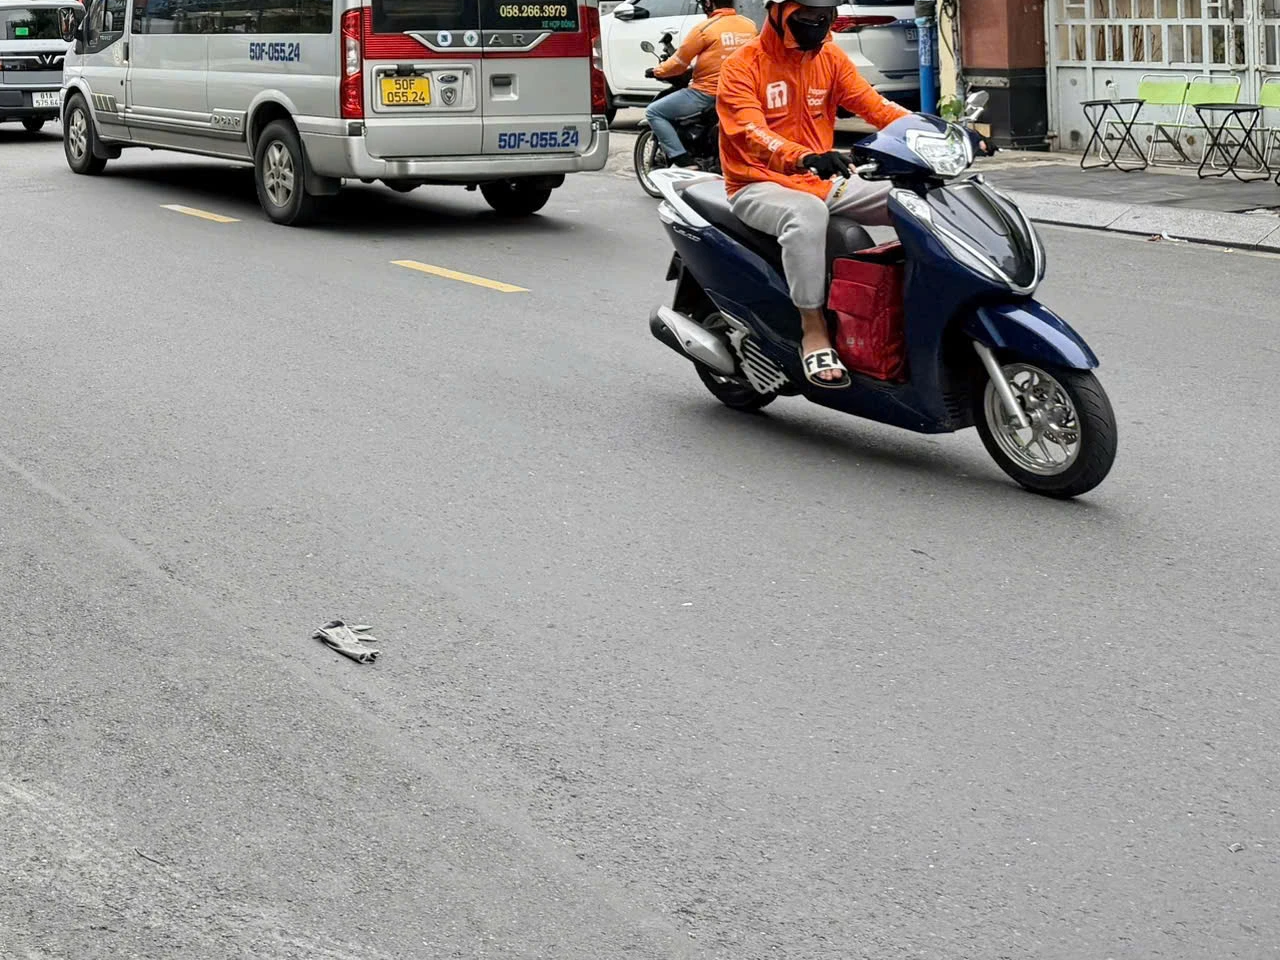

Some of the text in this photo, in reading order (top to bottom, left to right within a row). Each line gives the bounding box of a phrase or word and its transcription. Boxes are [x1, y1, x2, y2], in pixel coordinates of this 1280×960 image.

[500, 5, 567, 17] 058.266.3979
[249, 42, 300, 62] 50F-055.24
[394, 78, 415, 90] 50F
[387, 91, 426, 103] 055.24
[498, 130, 579, 150] 50F-055.24
